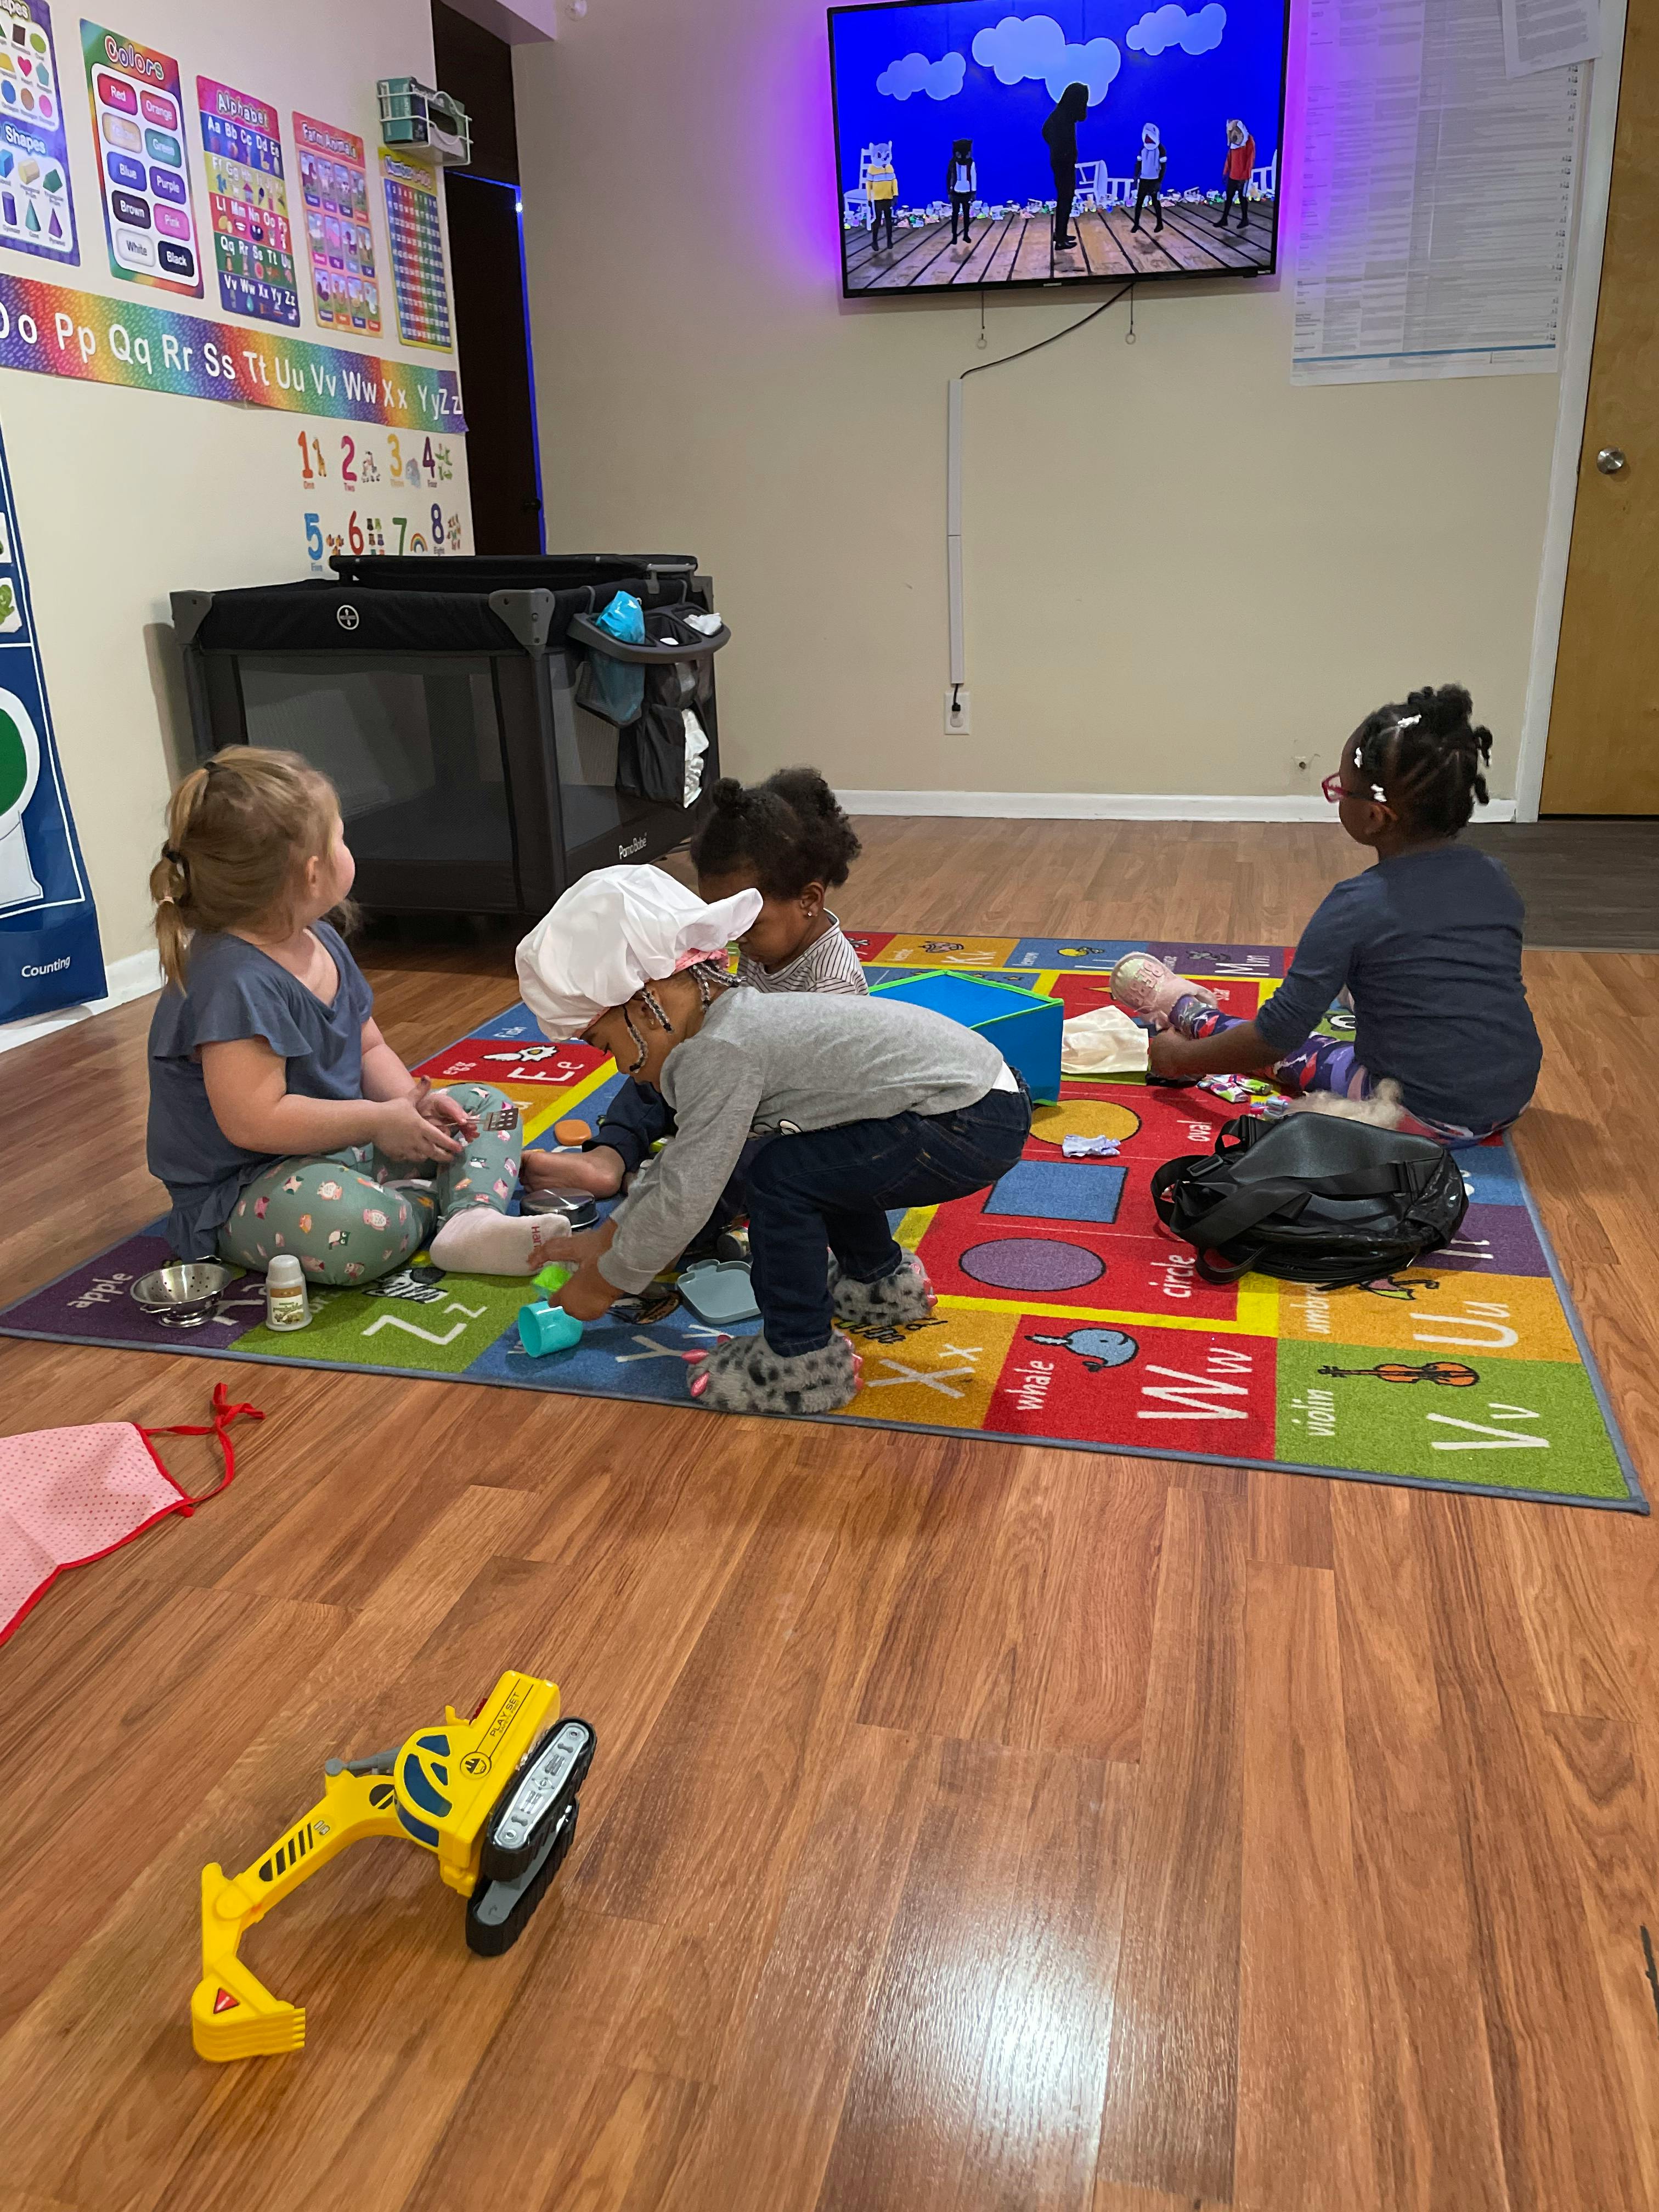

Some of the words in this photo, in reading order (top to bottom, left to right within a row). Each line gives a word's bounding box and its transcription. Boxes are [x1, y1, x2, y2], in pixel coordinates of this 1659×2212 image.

[0, 0, 28, 19] apes
[105, 35, 164, 81] Colors
[111, 86, 126, 102] Red
[145, 99, 172, 121] Orange
[218, 92, 268, 129] Alphabet
[5, 125, 46, 154] Shapes
[153, 138, 174, 157] Green
[207, 116, 221, 134] Aa
[225, 122, 237, 140] Bb
[241, 129, 252, 146] Cc
[256, 136, 267, 152] Dd
[270, 143, 279, 157] Ee
[119, 163, 137, 180] Blue
[157, 174, 180, 195] Purple
[120, 200, 145, 218] Brown
[165, 213, 180, 229] Pink
[231, 201, 246, 218] Mm
[249, 206, 259, 222] Nn
[263, 212, 275, 228] Oo
[126, 240, 147, 257] White
[166, 250, 187, 267] Black
[221, 236, 235, 255] Qq
[239, 240, 248, 256] Rr
[253, 245, 263, 261] Ss
[267, 250, 278, 265] Tt
[281, 253, 291, 269] Uu
[224, 274, 237, 290] Vv
[240, 278, 256, 295] Ww
[258, 284, 269, 300] Xx
[271, 287, 281, 307] Yy
[285, 291, 295, 306] Zz
[55, 312, 96, 364] Pp
[109, 324, 153, 375] Qq
[162, 334, 193, 371] Rr
[204, 343, 236, 380] Ss
[242, 351, 270, 386] Tt
[274, 357, 304, 392] Uu
[311, 364, 336, 397] Vv
[342, 369, 376, 404] Ww
[382, 379, 407, 410] Xx
[417, 385, 439, 421] Yy
[438, 388, 463, 415] Zz
[297, 431, 313, 478] 1
[341, 435, 357, 482] 2
[387, 433, 402, 477] 3
[422, 436, 435, 478] 4
[304, 513, 323, 561] 5
[349, 510, 364, 555] 6
[393, 517, 407, 556] 7
[431, 503, 444, 544] 8
[21, 956, 71, 978] Counting
[941, 951, 996, 965] Kk
[1215, 955, 1270, 975] Mm
[443, 1061, 477, 1075] egg
[507, 1061, 584, 1081] Ee
[1177, 1120, 1212, 1142] oval
[531, 1226, 541, 1248] Han
[67, 1272, 133, 1308] apple
[1148, 1255, 1195, 1298] circle
[361, 1302, 488, 1345] Zz
[1410, 1301, 1518, 1348] Uu
[866, 1344, 983, 1398] Xx
[1004, 1361, 1054, 1410] whale
[1137, 1347, 1252, 1419] Ww
[1291, 1389, 1335, 1436] violin
[1427, 1403, 1550, 1450] Vv
[490, 1712, 507, 1737] PLAY
[506, 1692, 520, 1711] SET
